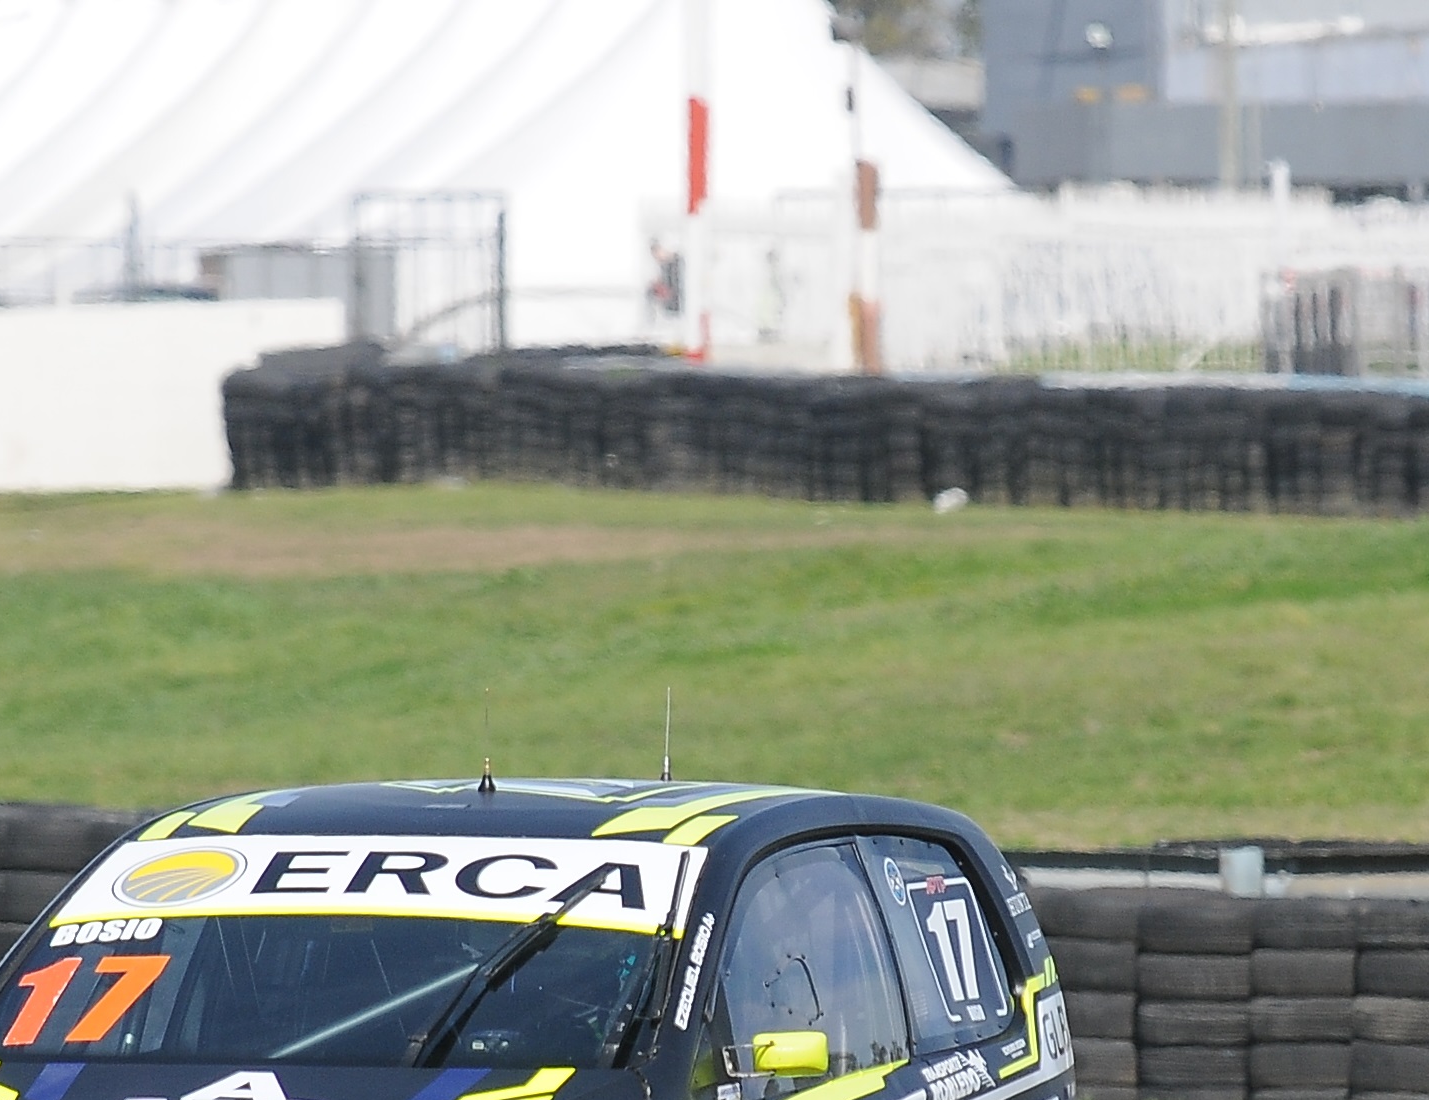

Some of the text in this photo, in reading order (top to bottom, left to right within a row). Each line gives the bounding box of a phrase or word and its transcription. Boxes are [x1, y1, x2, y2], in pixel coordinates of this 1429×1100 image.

[251, 850, 646, 911] ERCA
[50, 917, 163, 948] BOSIO
[925, 898, 980, 1002] 17
[2, 954, 172, 1047] 17
